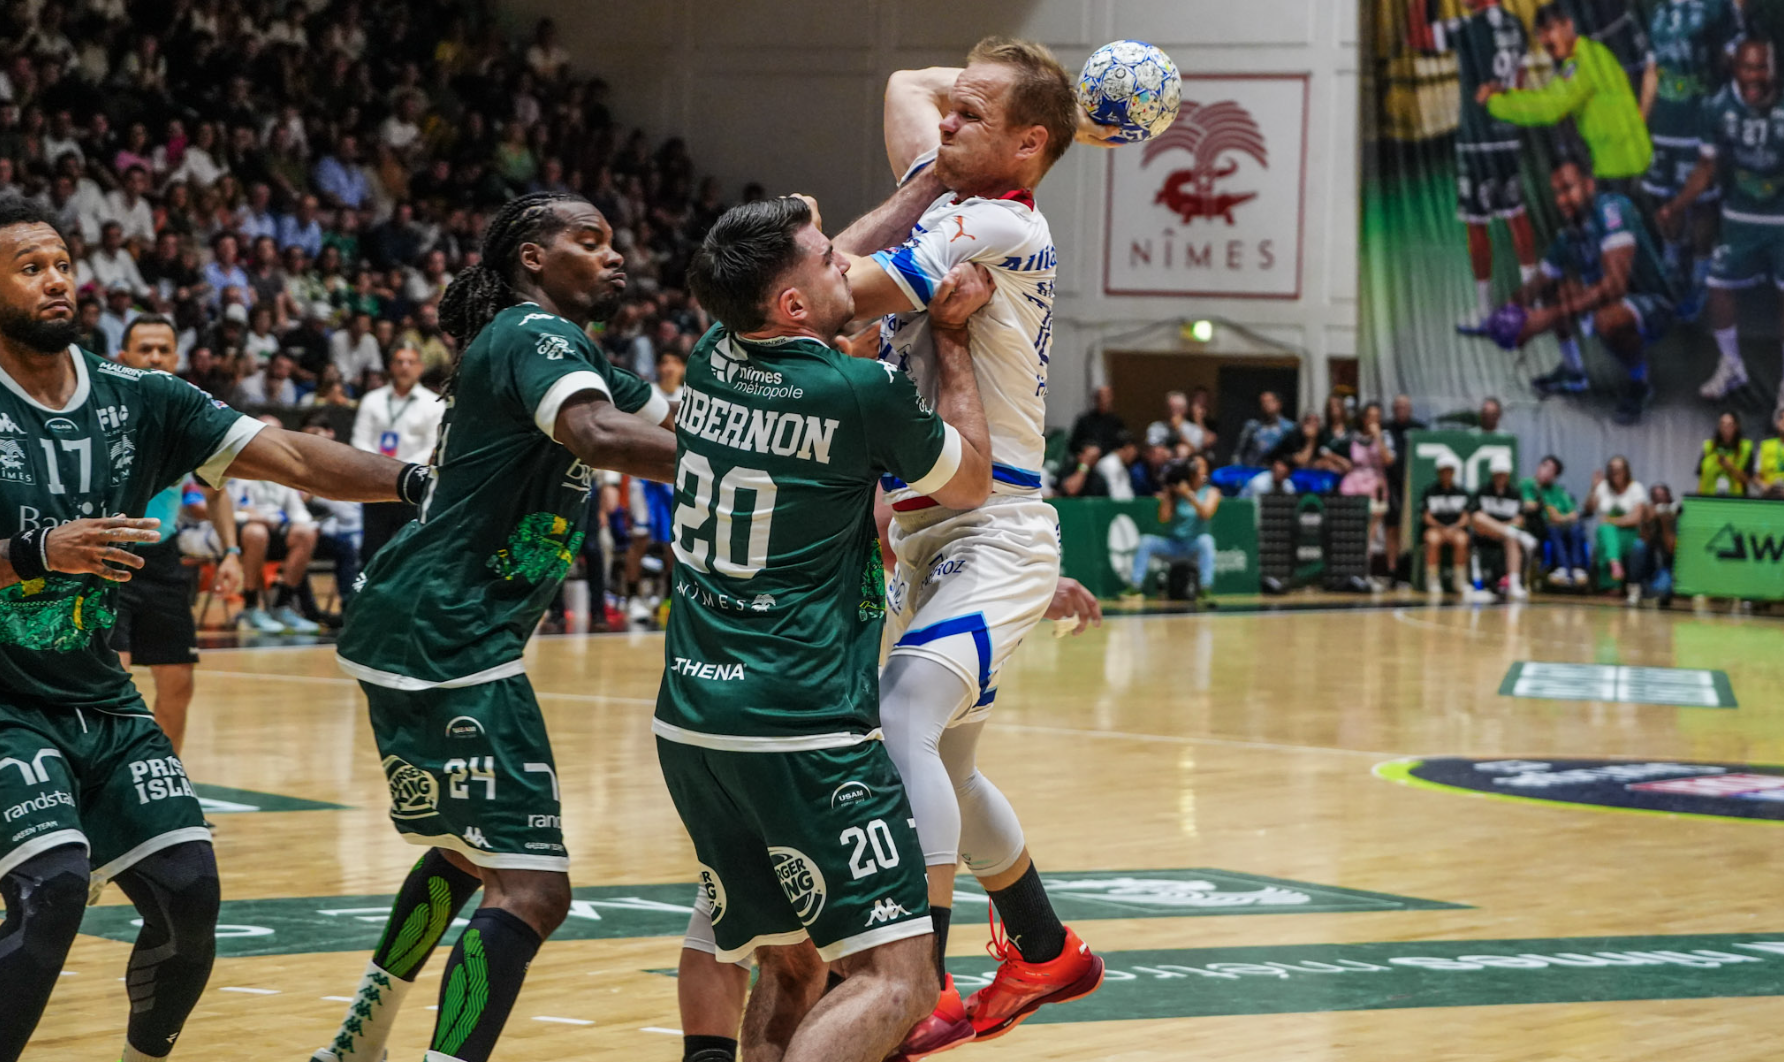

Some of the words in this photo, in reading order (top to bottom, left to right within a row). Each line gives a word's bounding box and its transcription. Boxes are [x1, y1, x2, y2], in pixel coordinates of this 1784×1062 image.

[1129, 227, 1276, 270] NÎMES
[733, 381, 804, 400] métropole
[739, 366, 782, 385] nîmes
[39, 436, 92, 494] 17
[671, 449, 778, 580] 20
[128, 755, 187, 784] PRIS
[443, 756, 496, 800] 24
[3, 790, 76, 823] randsta
[134, 777, 197, 805] ISLA
[838, 790, 864, 802] USAM
[839, 819, 900, 880] 20
